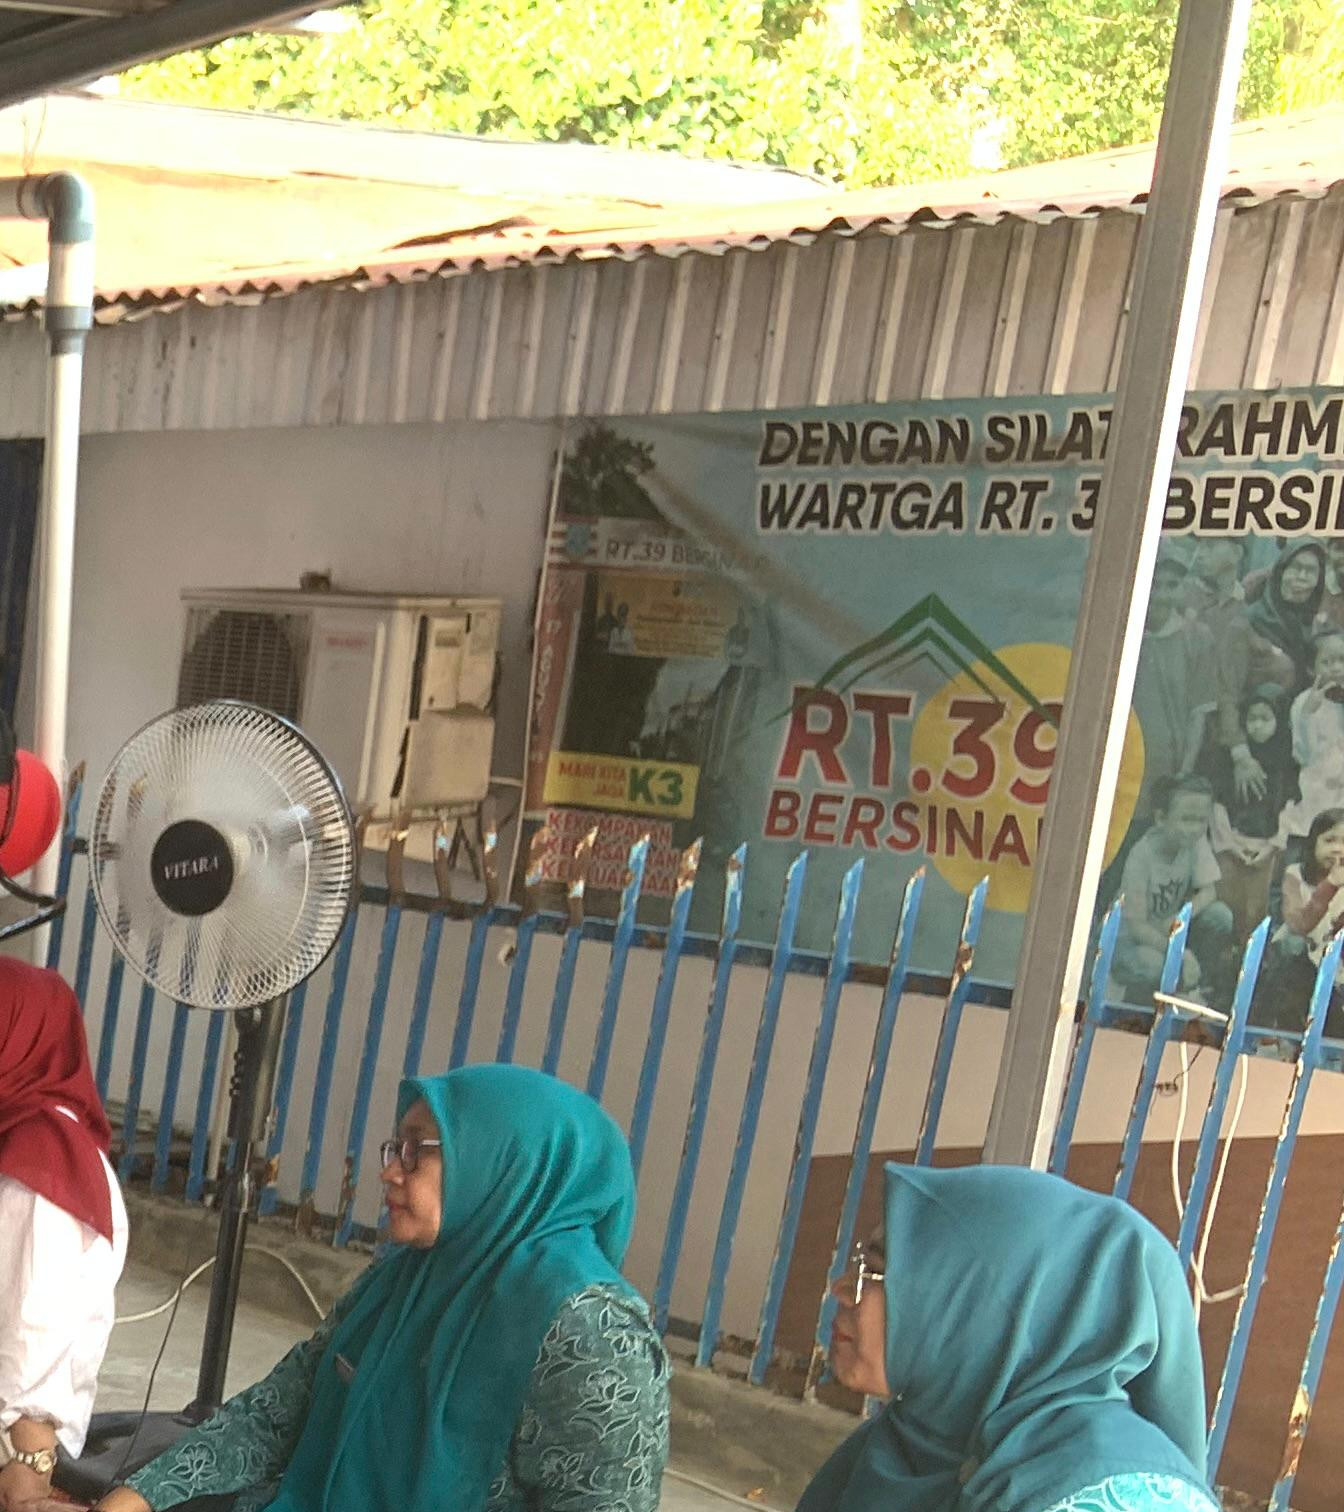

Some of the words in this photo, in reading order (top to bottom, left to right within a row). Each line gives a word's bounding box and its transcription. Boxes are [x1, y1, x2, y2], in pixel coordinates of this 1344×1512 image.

[758, 417, 971, 467] DENGAN
[759, 481, 966, 530] WARTGA
[979, 481, 1052, 530] RT.
[777, 684, 1064, 805] RT.39
[627, 765, 685, 806] K3
[764, 789, 1044, 867] BERSINA
[164, 855, 220, 880] VITARA
